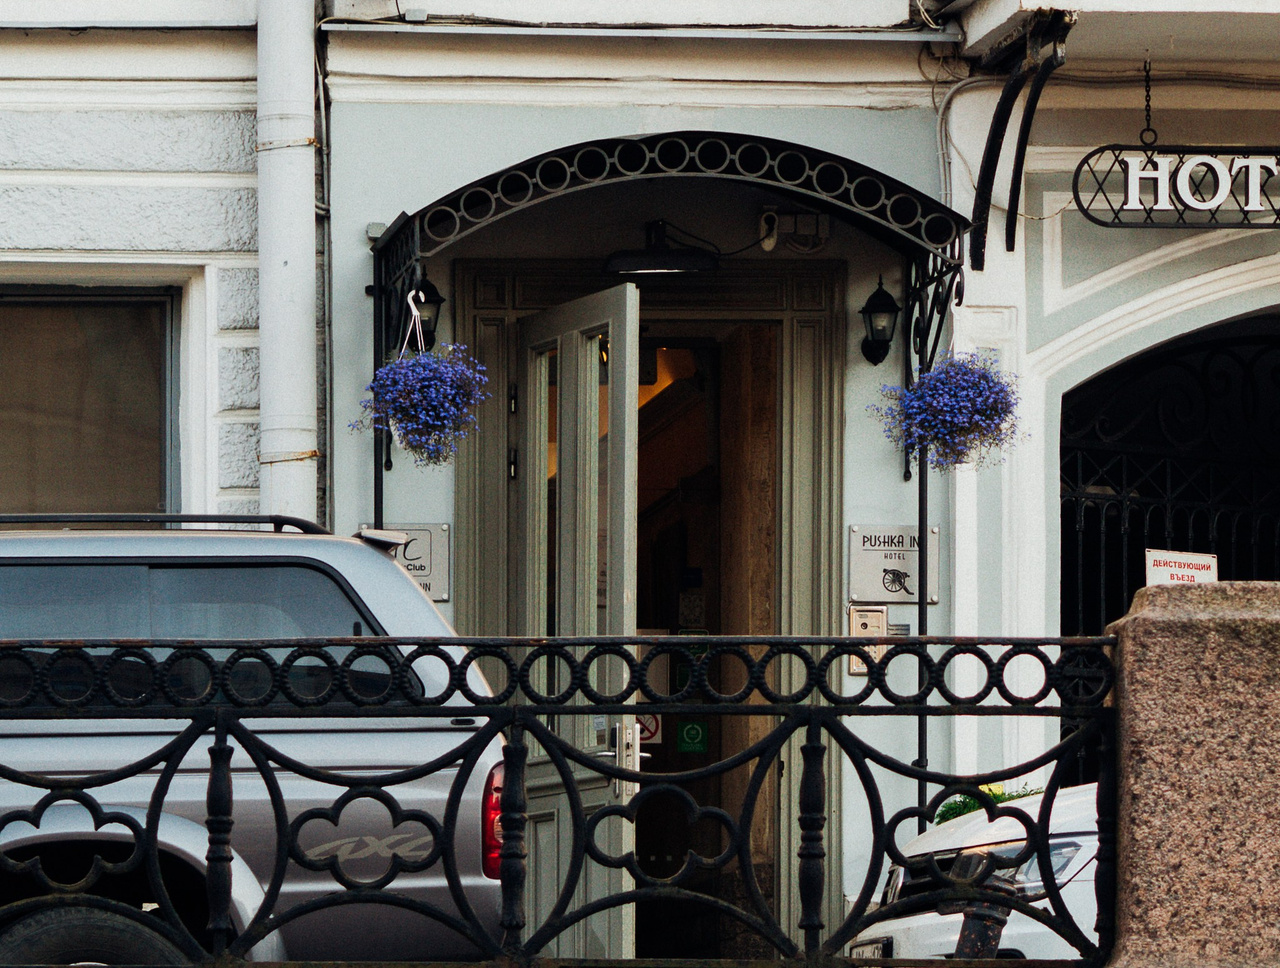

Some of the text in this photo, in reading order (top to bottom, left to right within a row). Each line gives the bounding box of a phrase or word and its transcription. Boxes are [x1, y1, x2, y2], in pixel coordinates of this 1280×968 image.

[862, 535, 919, 547] PUSHKA IN
[403, 563, 426, 572] Club
[1153, 559, 1211, 571] ДЕЙСТВУЮЩИЙ
[1170, 573, 1195, 582] ВЪЕЗД
